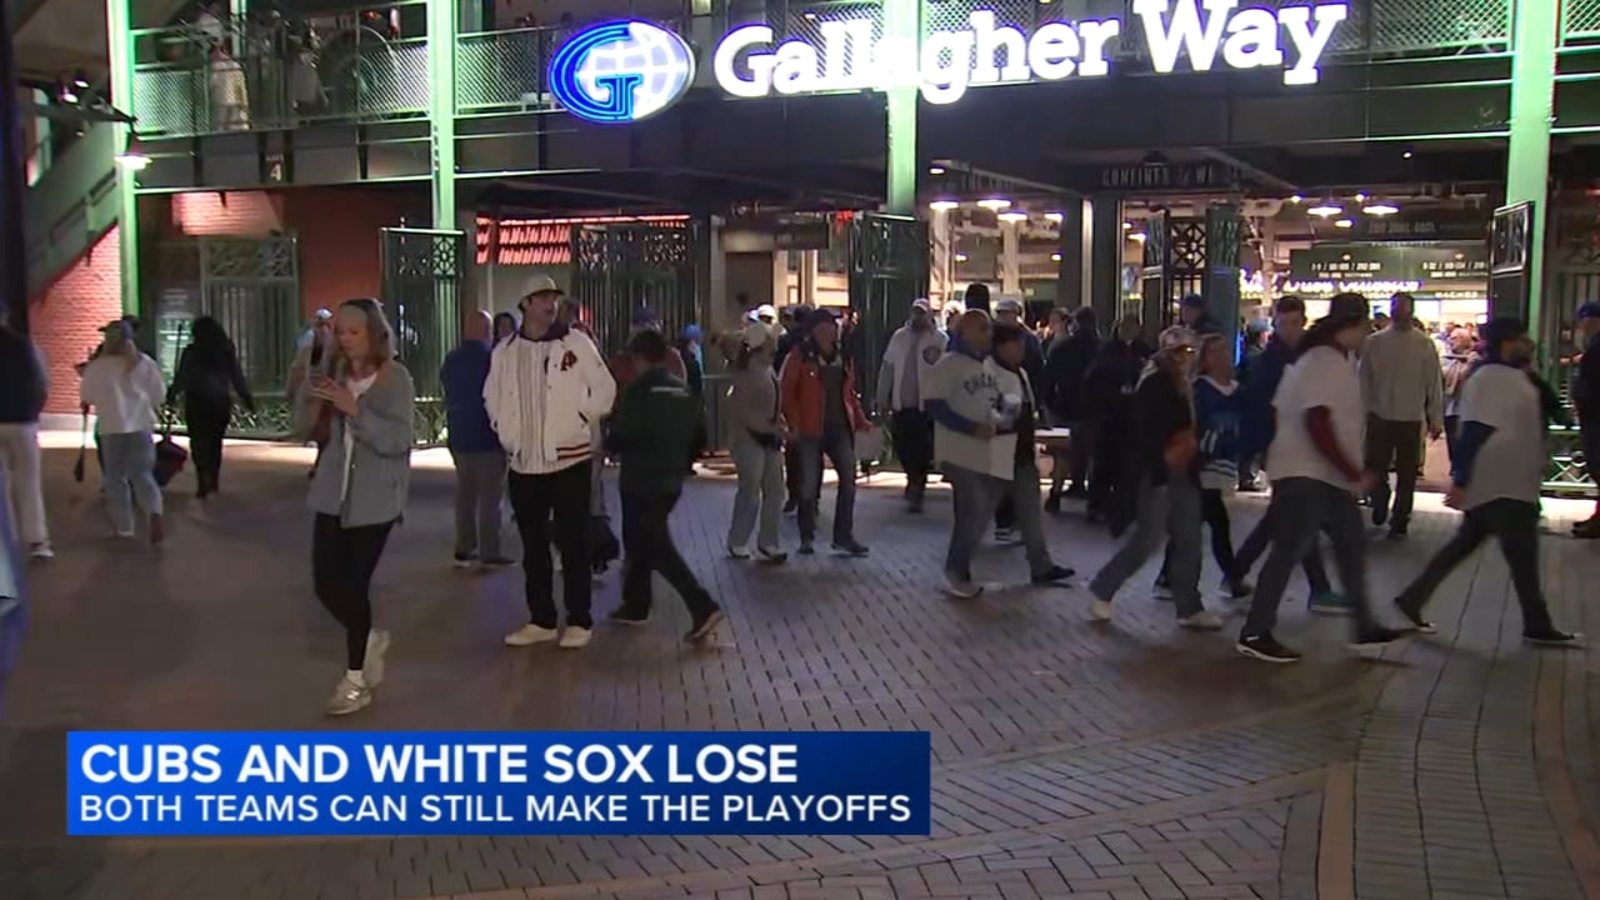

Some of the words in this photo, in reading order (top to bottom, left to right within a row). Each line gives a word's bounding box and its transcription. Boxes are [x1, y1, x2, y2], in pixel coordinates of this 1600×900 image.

[713, 8, 1120, 104] Gallagher
[1133, 0, 1347, 85] Way
[270, 164, 282, 181] 4
